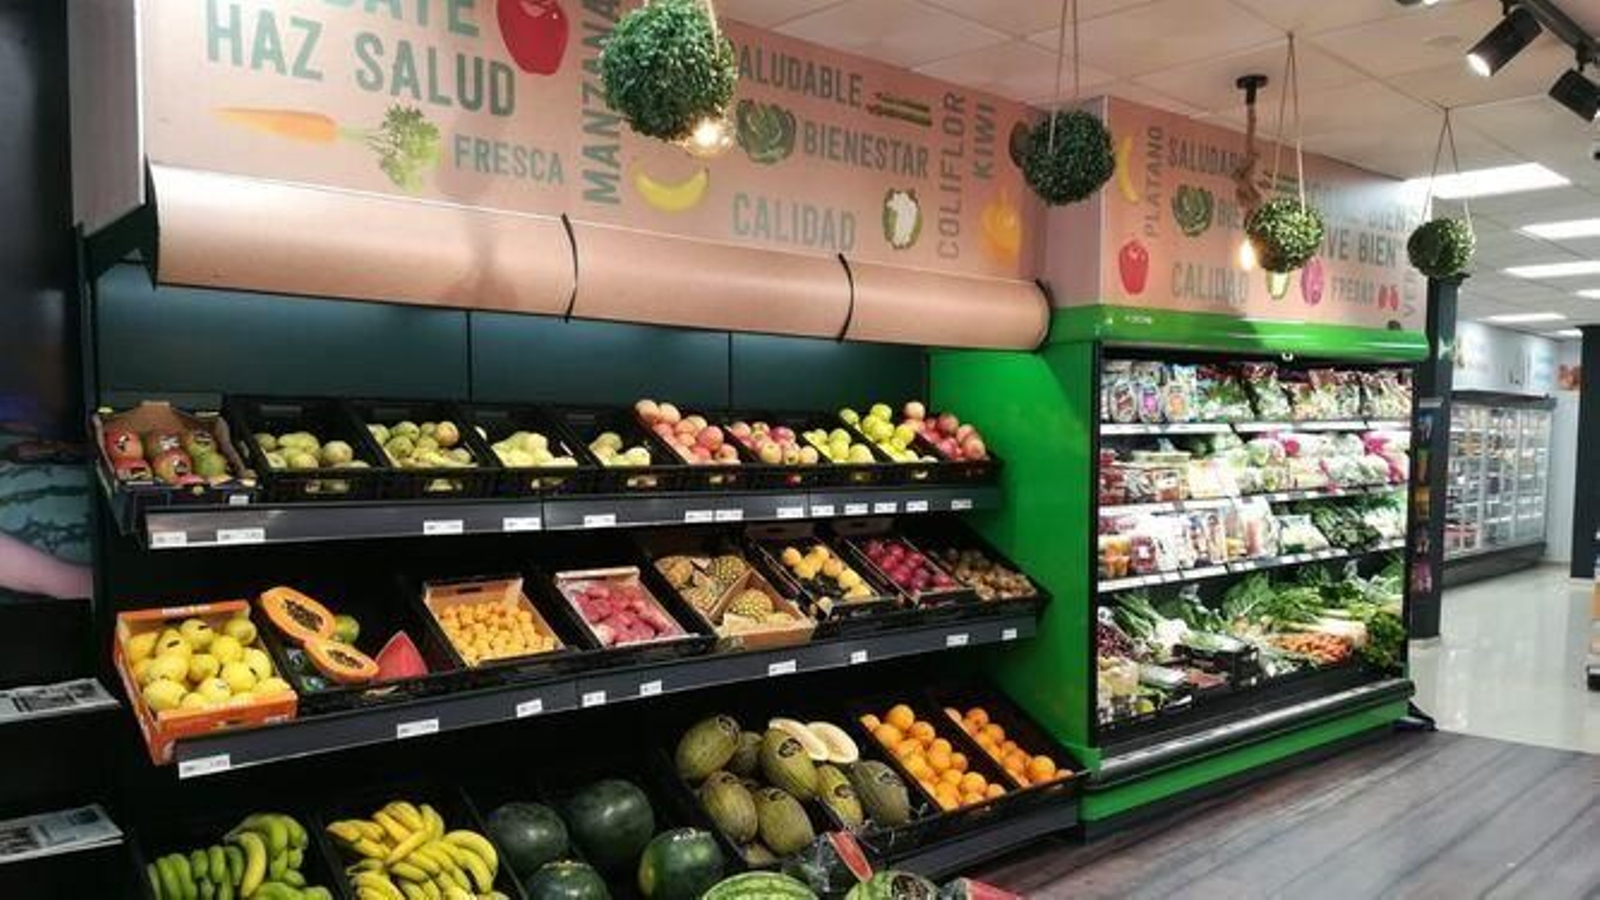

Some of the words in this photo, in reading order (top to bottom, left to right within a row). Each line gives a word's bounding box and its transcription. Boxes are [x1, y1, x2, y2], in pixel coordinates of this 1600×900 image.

[206, 0, 324, 81] HAZ
[354, 31, 515, 118] SALUD
[738, 44, 863, 108] ALUDABLE
[454, 134, 565, 184] FRESCA
[804, 119, 929, 180] BIENESTAR
[973, 103, 997, 179] KIWI
[937, 91, 967, 260] COLIFLOR
[732, 191, 857, 252] CALIDAD
[1358, 230, 1397, 267] BIEN
[1171, 260, 1250, 304] CALIDAD
